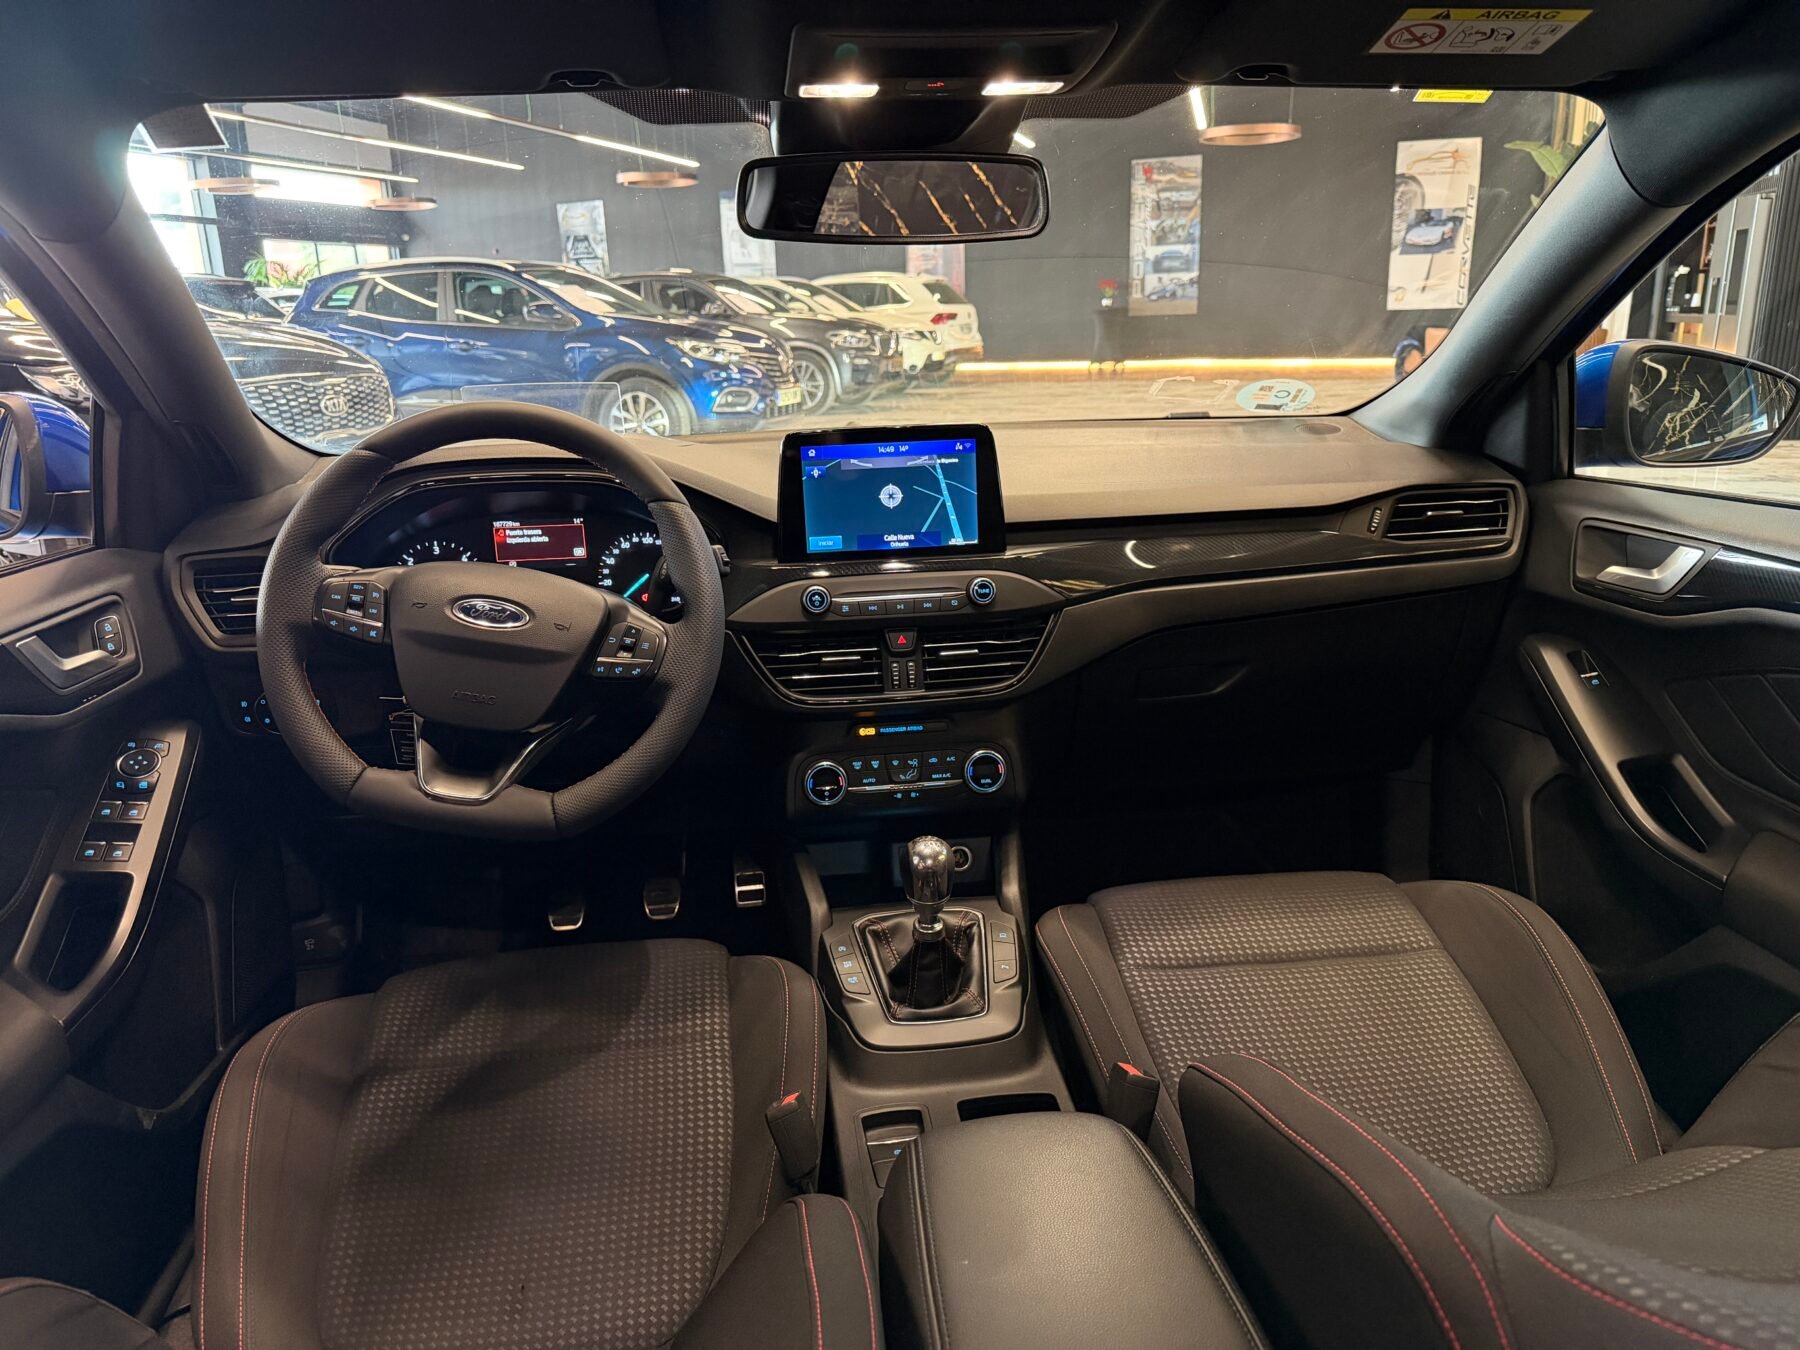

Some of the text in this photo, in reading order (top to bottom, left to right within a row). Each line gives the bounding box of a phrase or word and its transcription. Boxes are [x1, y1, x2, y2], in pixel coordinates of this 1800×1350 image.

[1475, 10, 1560, 20] AIRBAG
[433, 546, 440, 555] 3
[407, 557, 415, 566] 2
[470, 603, 510, 620] Ford
